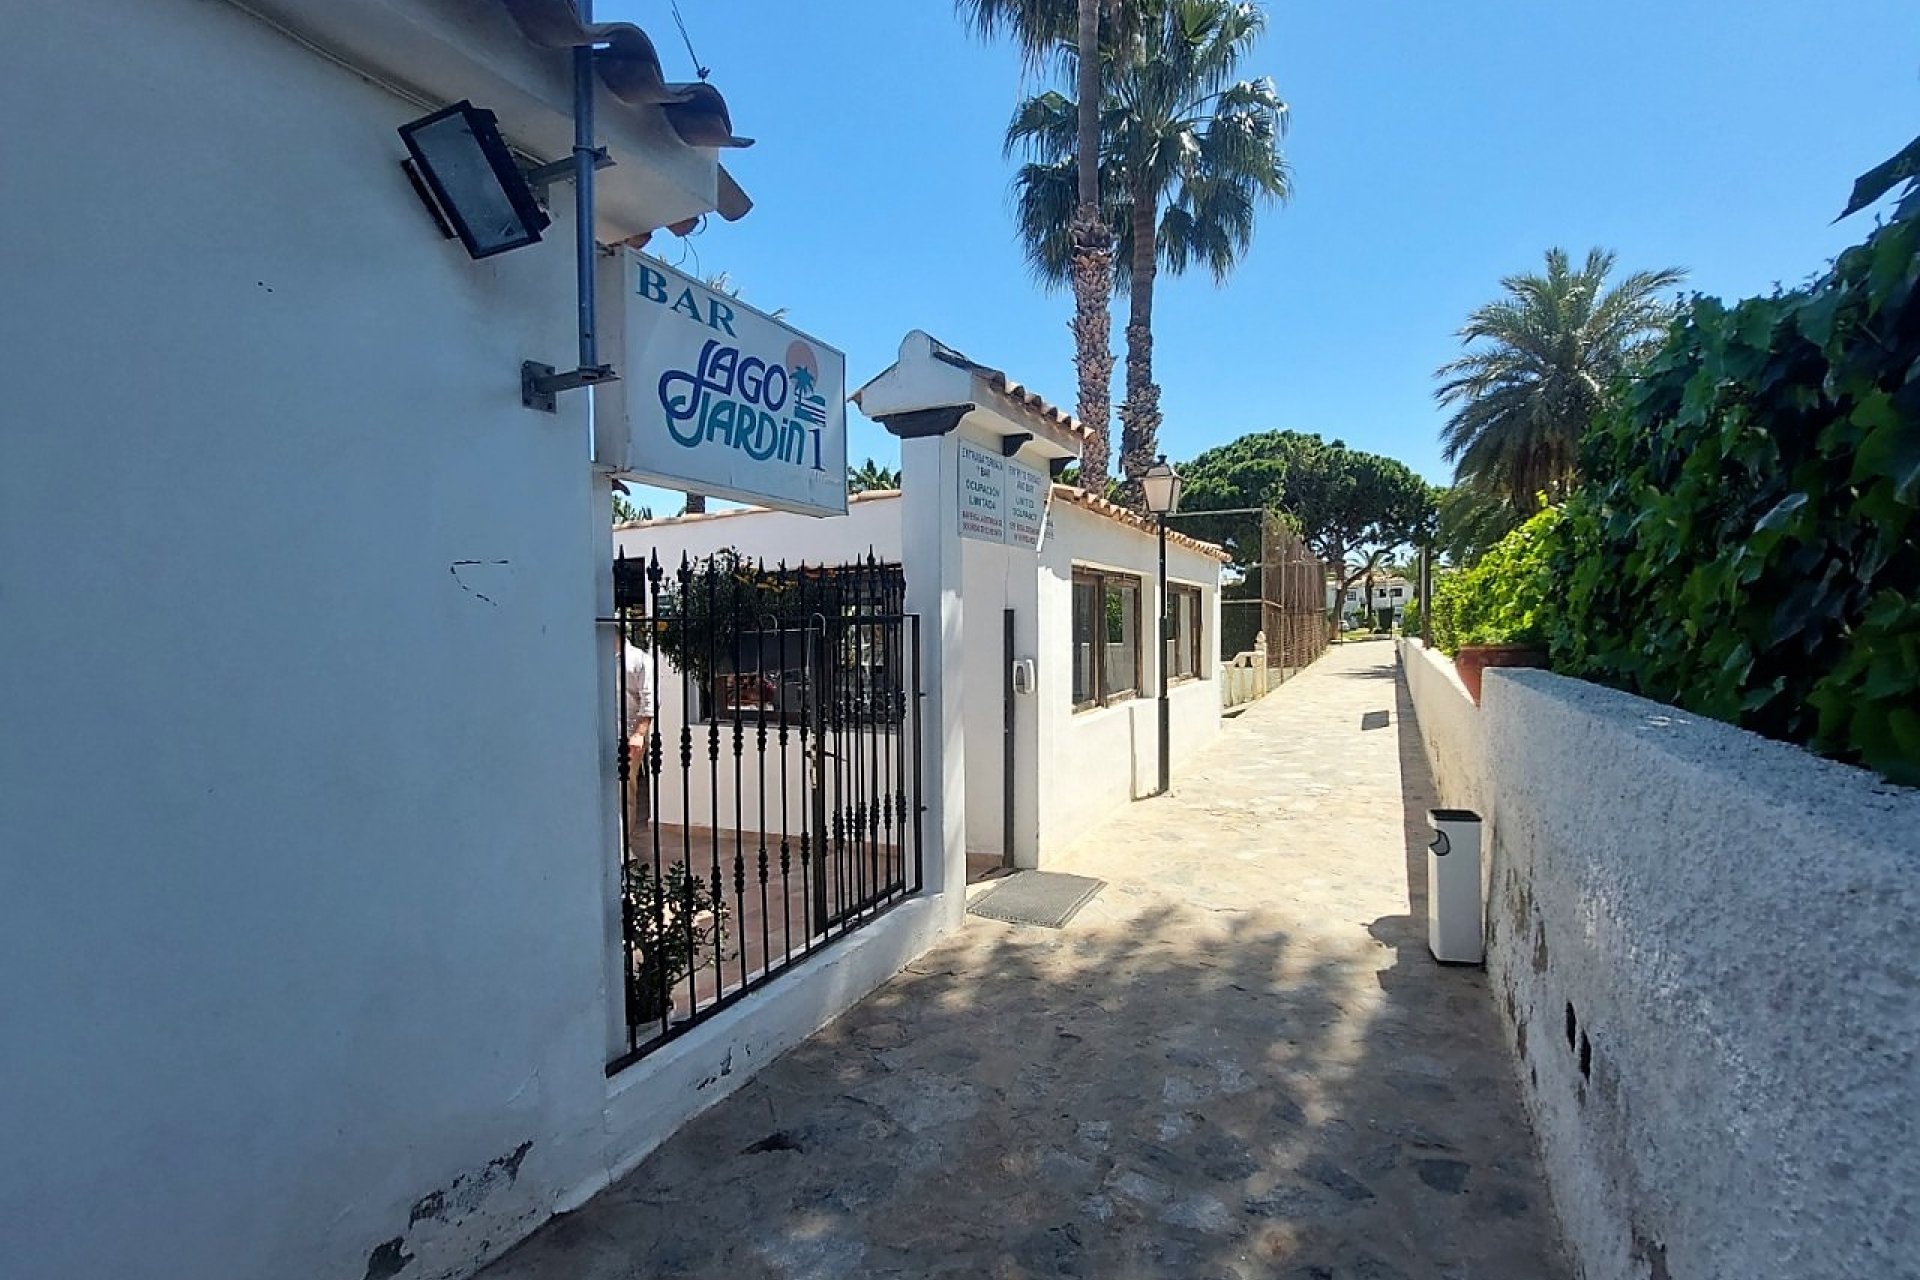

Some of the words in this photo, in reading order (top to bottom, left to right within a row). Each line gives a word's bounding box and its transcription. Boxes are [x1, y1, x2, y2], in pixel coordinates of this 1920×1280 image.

[636, 261, 737, 338] BAR
[658, 339, 788, 420] LAGO
[809, 428, 826, 472] 1
